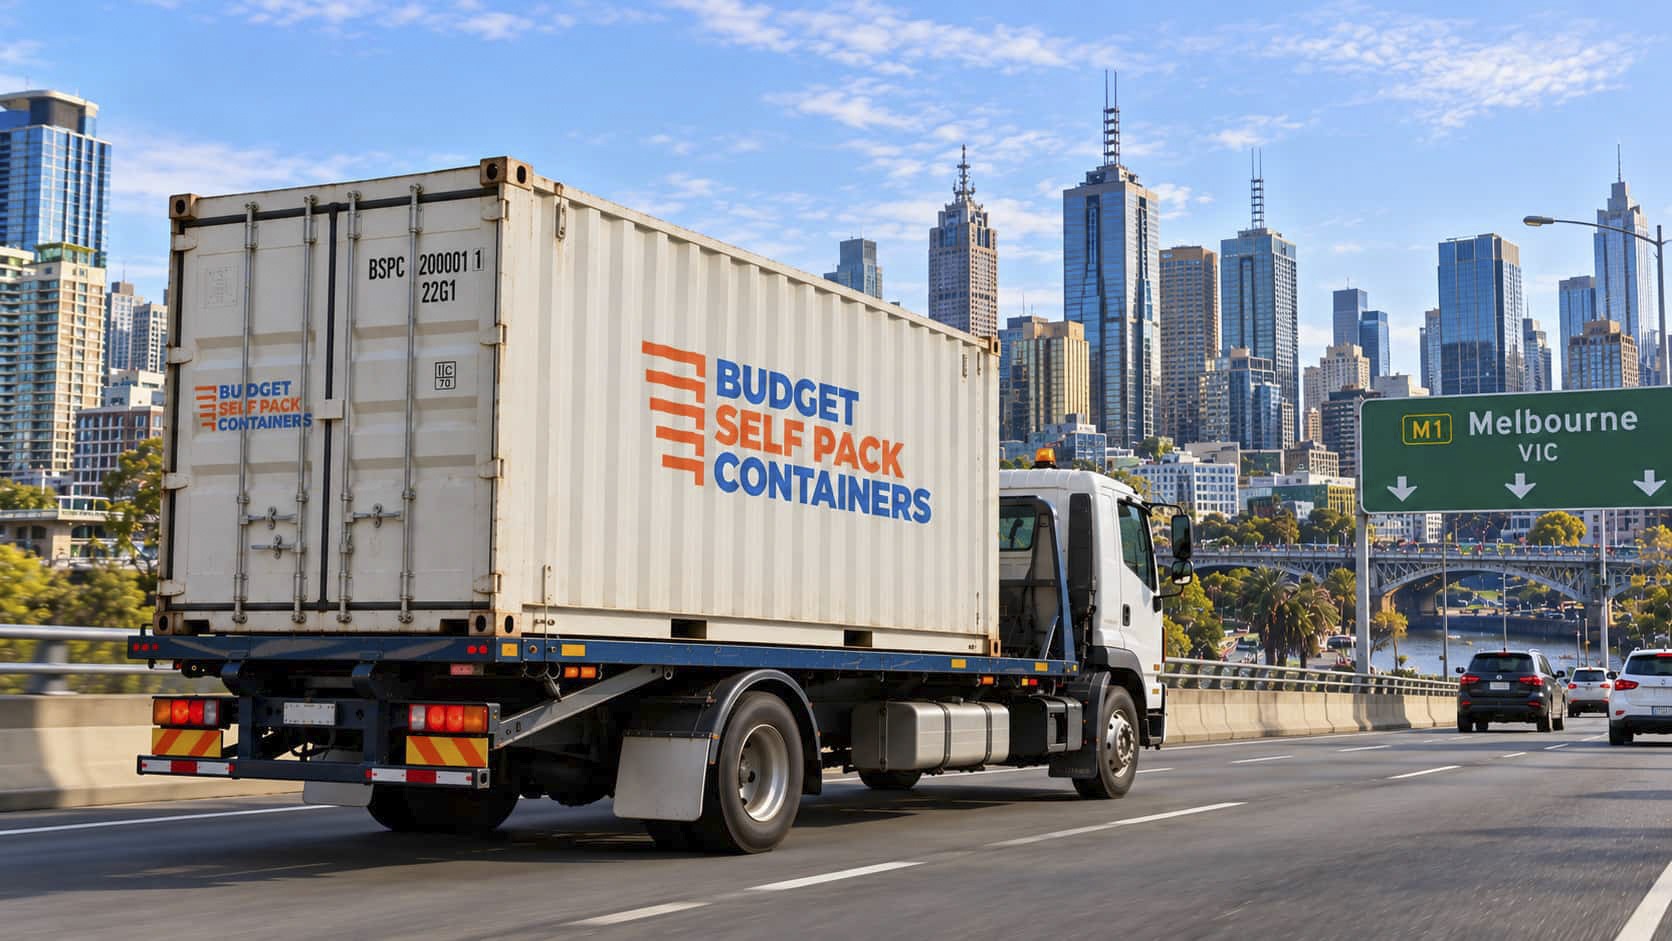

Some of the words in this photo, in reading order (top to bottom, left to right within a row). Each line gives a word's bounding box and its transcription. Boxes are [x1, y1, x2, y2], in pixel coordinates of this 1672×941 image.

[369, 256, 405, 280] BSPC
[419, 250, 467, 276] 200001
[475, 249, 481, 269] 1
[422, 279, 456, 303] 22G1
[219, 381, 292, 399] BUDGET
[440, 379, 451, 387] 70
[716, 358, 860, 426] BUDGET
[259, 397, 301, 413] PACK
[218, 413, 312, 431] CONTAINERS
[1412, 419, 1441, 439] M1
[1469, 408, 1638, 435] Melbourne
[715, 405, 805, 457] SELF
[813, 425, 905, 478] PACK
[1518, 443, 1558, 462] VIC
[714, 452, 932, 524] CONTAINERS
